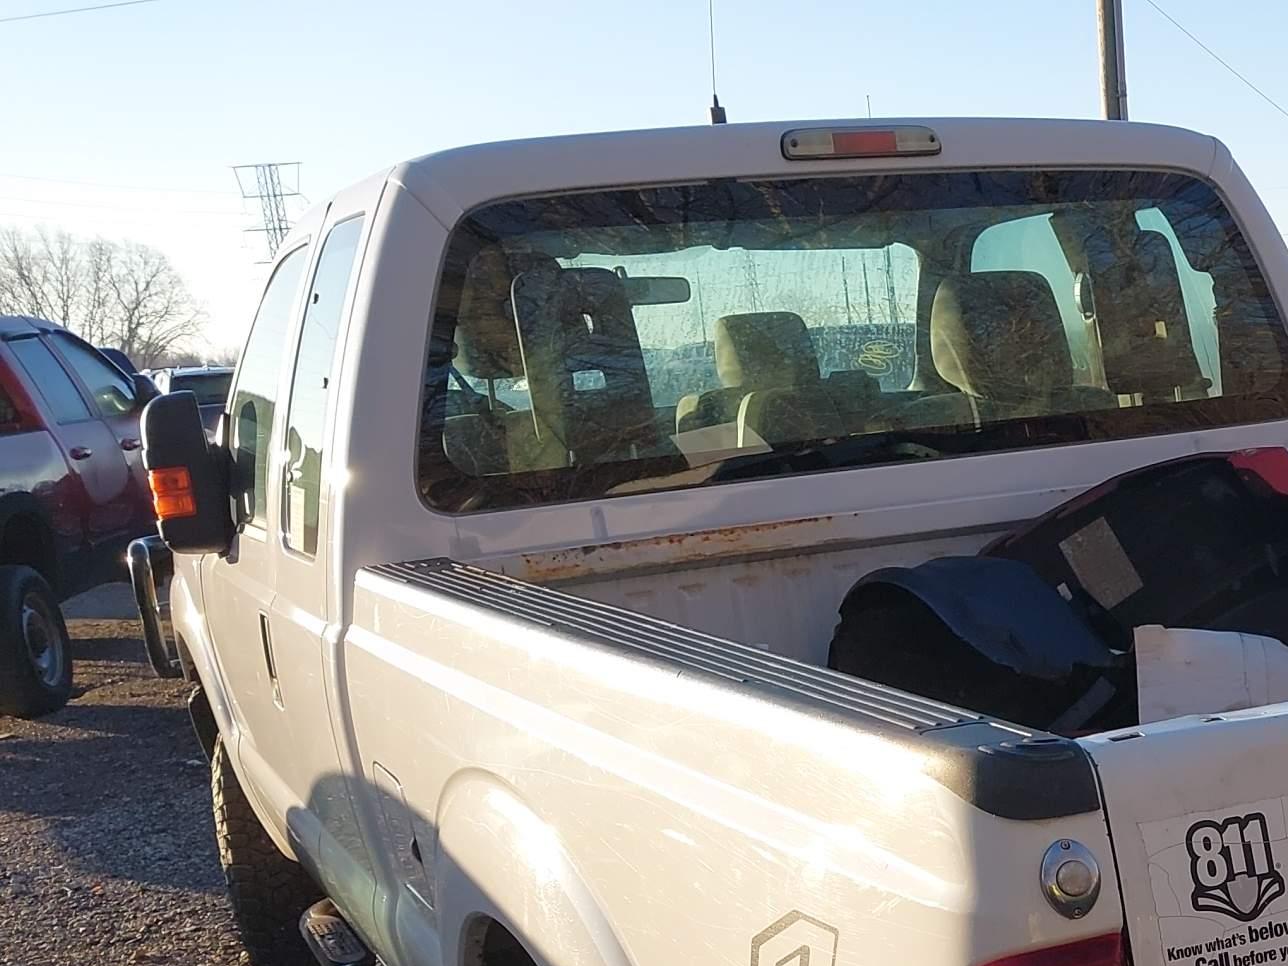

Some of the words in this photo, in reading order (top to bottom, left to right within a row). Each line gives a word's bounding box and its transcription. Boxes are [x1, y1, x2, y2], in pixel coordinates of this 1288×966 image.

[1189, 816, 1271, 888] 811
[1167, 943, 1203, 961] Know
[1205, 932, 1247, 954] what's
